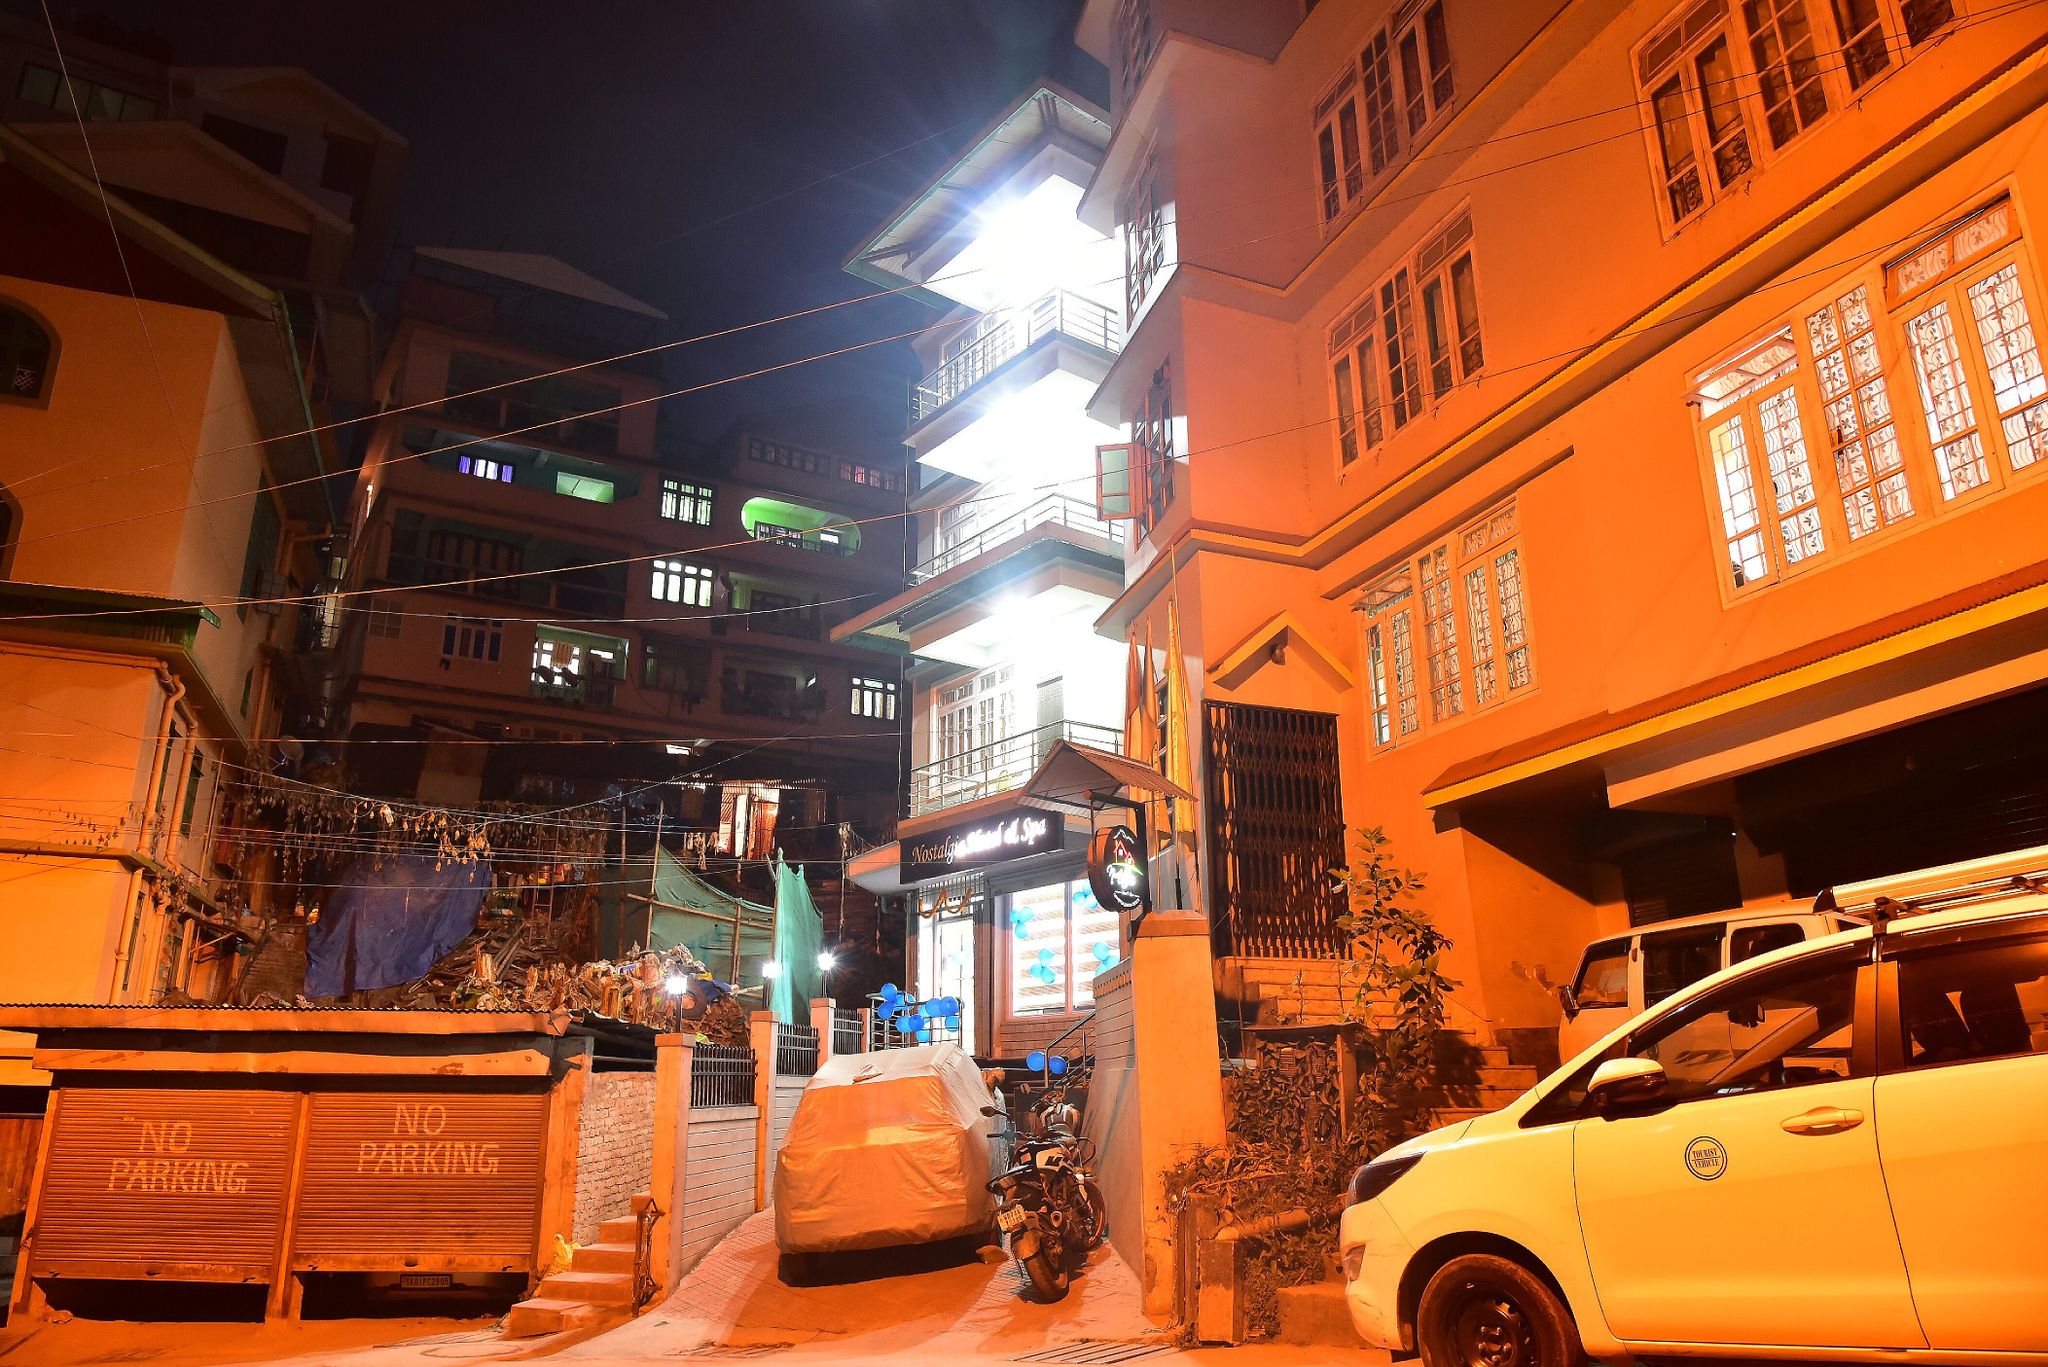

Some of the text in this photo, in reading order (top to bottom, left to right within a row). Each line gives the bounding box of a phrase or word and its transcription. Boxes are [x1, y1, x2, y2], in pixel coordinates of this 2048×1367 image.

[1020, 816, 1048, 846] Spa
[393, 1103, 447, 1136] NO
[138, 1120, 193, 1154] NO
[1692, 1147, 1718, 1159] TOURIST
[356, 1141, 501, 1175] PARKING
[1694, 1158, 1720, 1169] VEHICLE
[106, 1158, 250, 1194] PARKING
